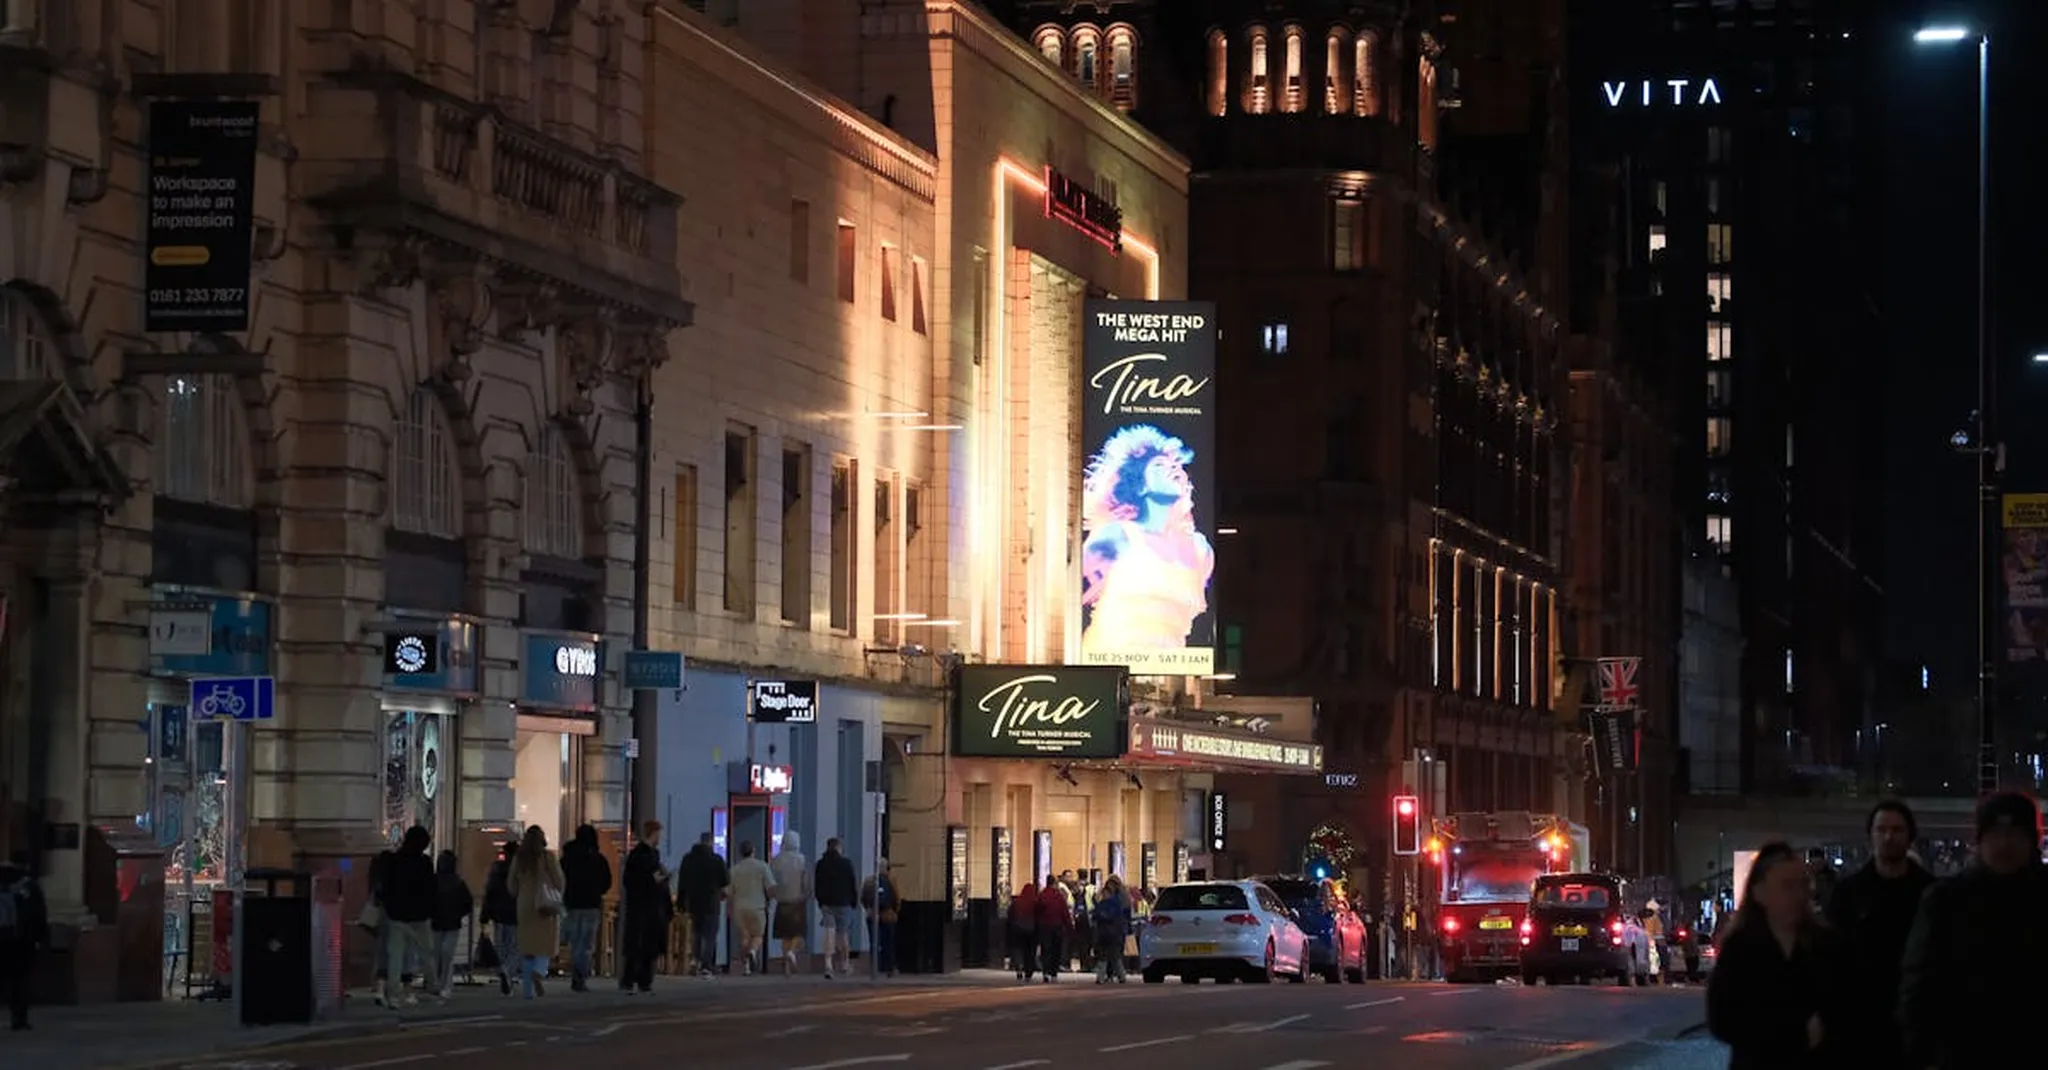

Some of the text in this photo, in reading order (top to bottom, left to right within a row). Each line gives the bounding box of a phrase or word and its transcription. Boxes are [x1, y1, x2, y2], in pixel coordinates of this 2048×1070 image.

[1603, 78, 1721, 106] VITA
[153, 175, 236, 192] Workspace
[152, 194, 235, 209] to make an
[152, 212, 235, 230] impression
[184, 288, 210, 303] 233
[1097, 313, 1205, 329] THE WEST END
[1115, 328, 1187, 342] MEGA HIT
[1091, 353, 1209, 414] Tina
[556, 646, 597, 676] GYROS
[1088, 652, 1108, 662] TUE
[1125, 653, 1150, 663] NOV
[1158, 654, 1177, 664] SAT
[1188, 655, 1210, 664] JAN
[760, 694, 810, 710] Stage Door
[978, 674, 1100, 738] Tina
[1214, 794, 1223, 836] BOX OFFICE
